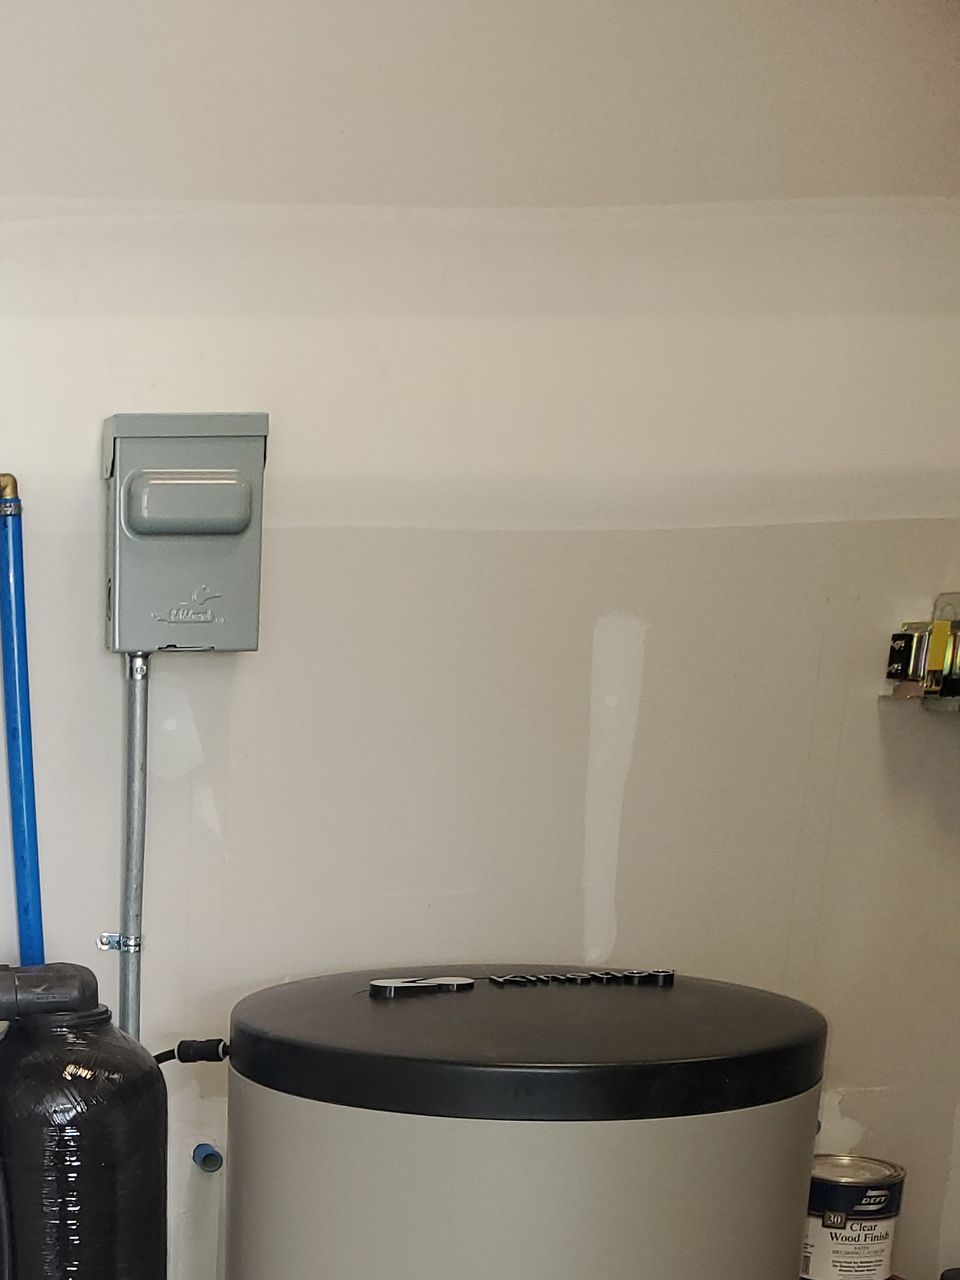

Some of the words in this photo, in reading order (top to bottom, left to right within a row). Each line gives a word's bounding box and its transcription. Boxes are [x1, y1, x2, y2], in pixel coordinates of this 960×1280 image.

[488, 969, 675, 990] Kinetico
[861, 1196, 887, 1204] DEFT
[827, 1214, 842, 1225] 30
[850, 1222, 879, 1232] Clear
[829, 1231, 860, 1243] Wood
[863, 1231, 890, 1243] Finish
